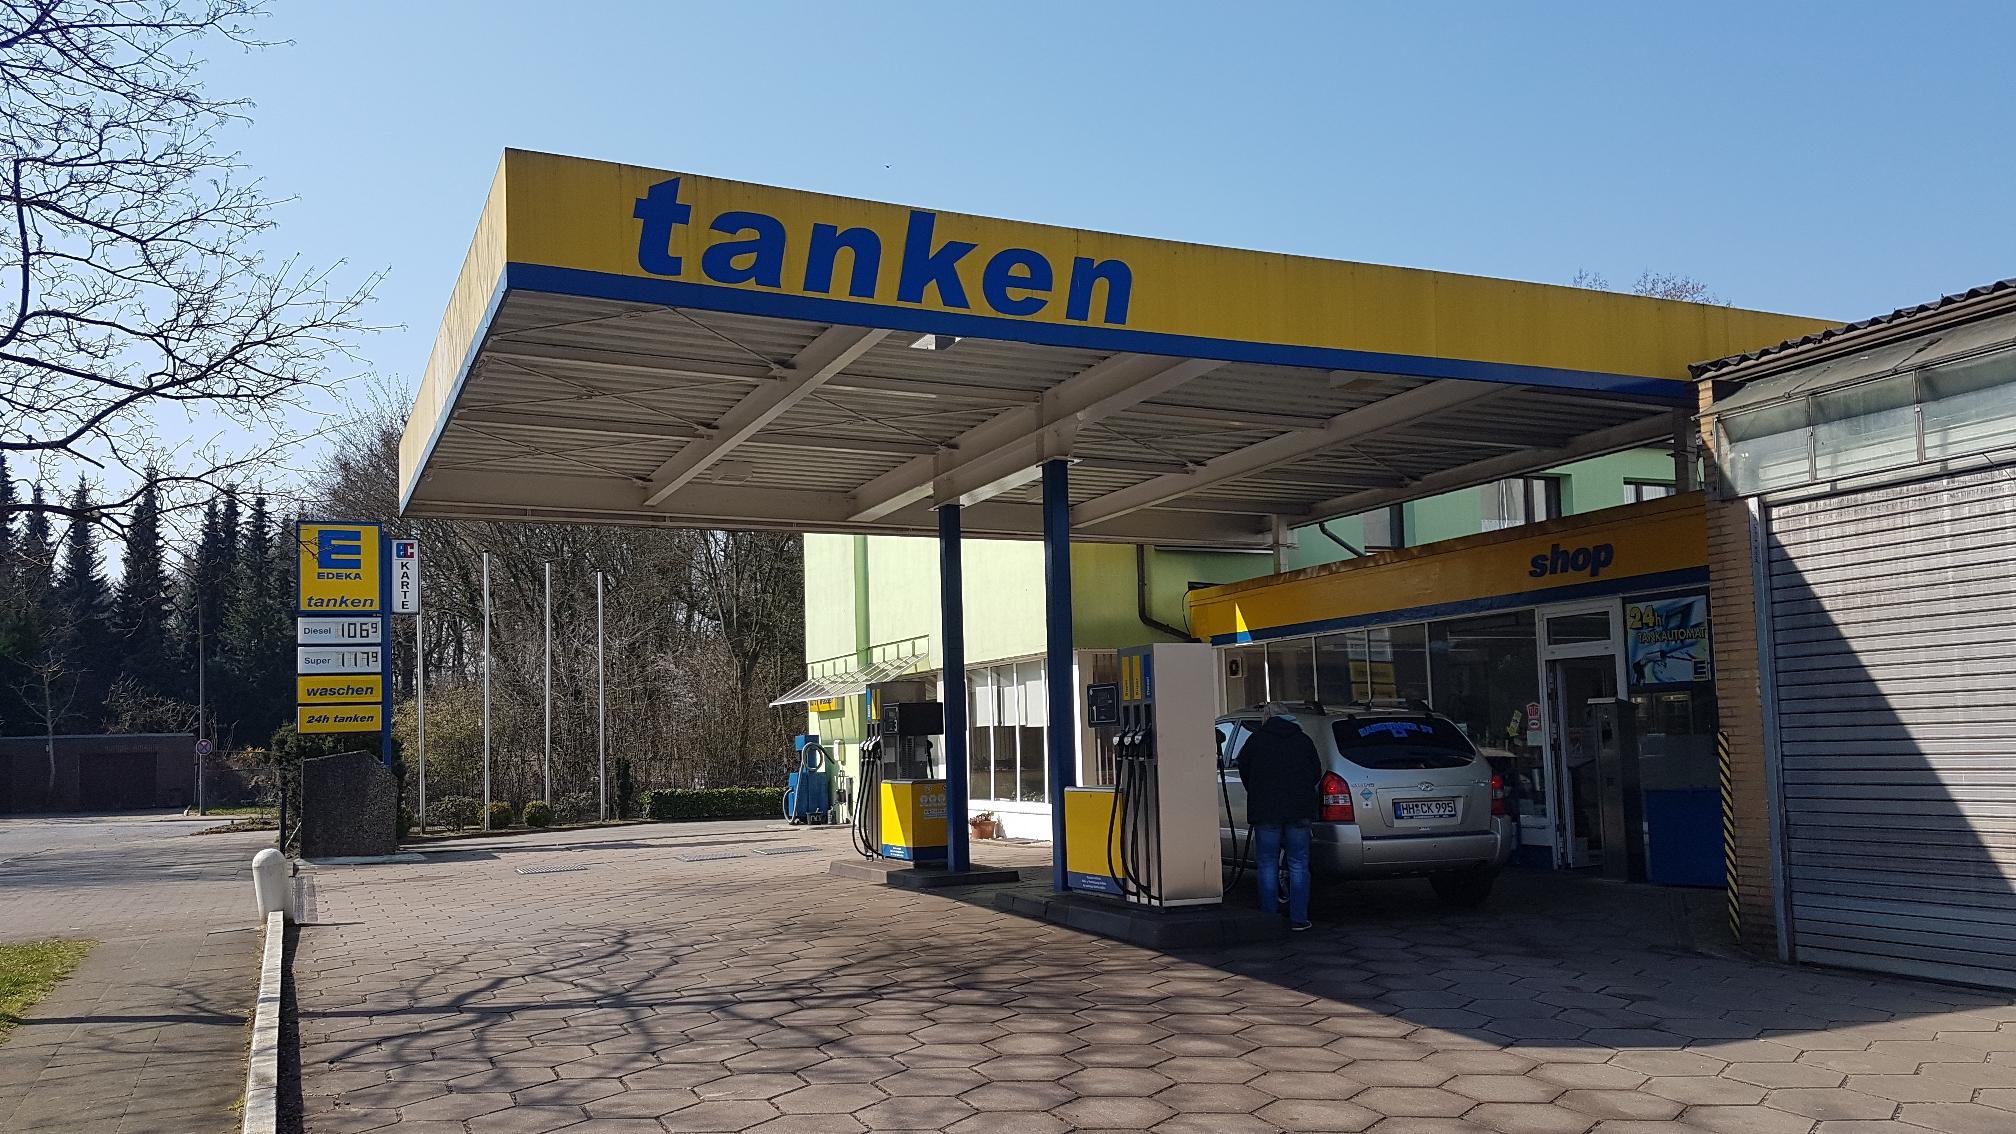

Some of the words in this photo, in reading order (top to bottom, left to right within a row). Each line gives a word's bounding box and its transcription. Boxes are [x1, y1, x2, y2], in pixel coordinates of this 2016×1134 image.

[633, 177, 1133, 325] tanken
[318, 530, 361, 569] E
[1529, 543, 1614, 577] shop
[317, 572, 362, 580] EDEKA
[400, 561, 410, 610] KARTE
[307, 595, 375, 607] tanken
[1629, 605, 1662, 628] 24h
[303, 627, 331, 635] Diesel
[1637, 626, 1707, 644] TANKAUTOMAT
[304, 657, 331, 666] Super
[306, 685, 374, 696] waschen
[306, 714, 330, 724] 24h
[333, 714, 375, 723] tanken
[1401, 803, 1415, 815] HH
[1420, 803, 1434, 814] CK
[1435, 802, 1454, 813] 995
